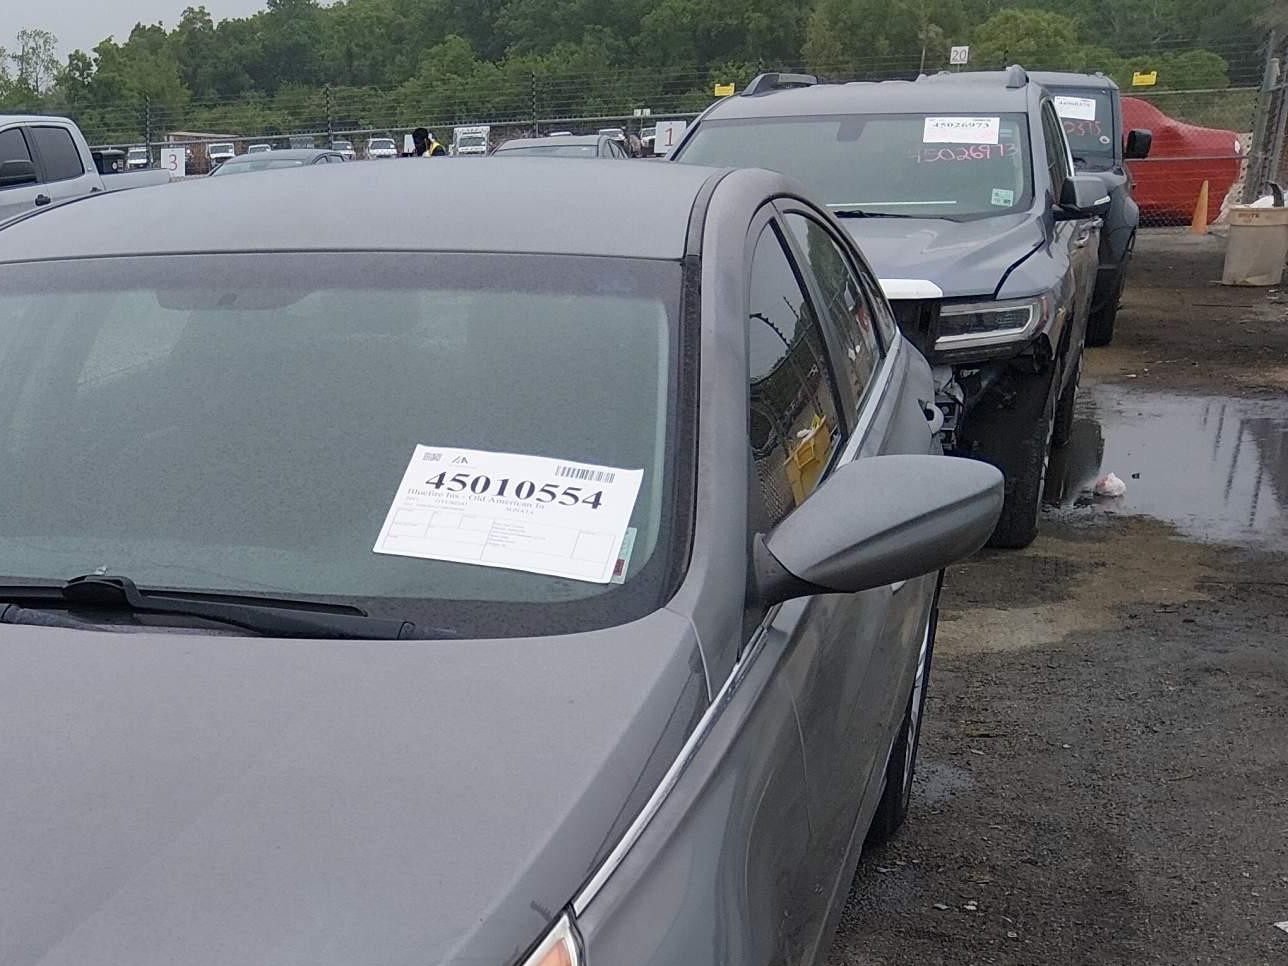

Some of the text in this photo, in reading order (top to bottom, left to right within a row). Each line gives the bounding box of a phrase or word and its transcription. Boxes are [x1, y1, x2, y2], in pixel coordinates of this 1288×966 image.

[952, 49, 967, 62] 20
[664, 127, 674, 147] 1
[168, 154, 177, 171] 3
[425, 471, 603, 510] 45010554
